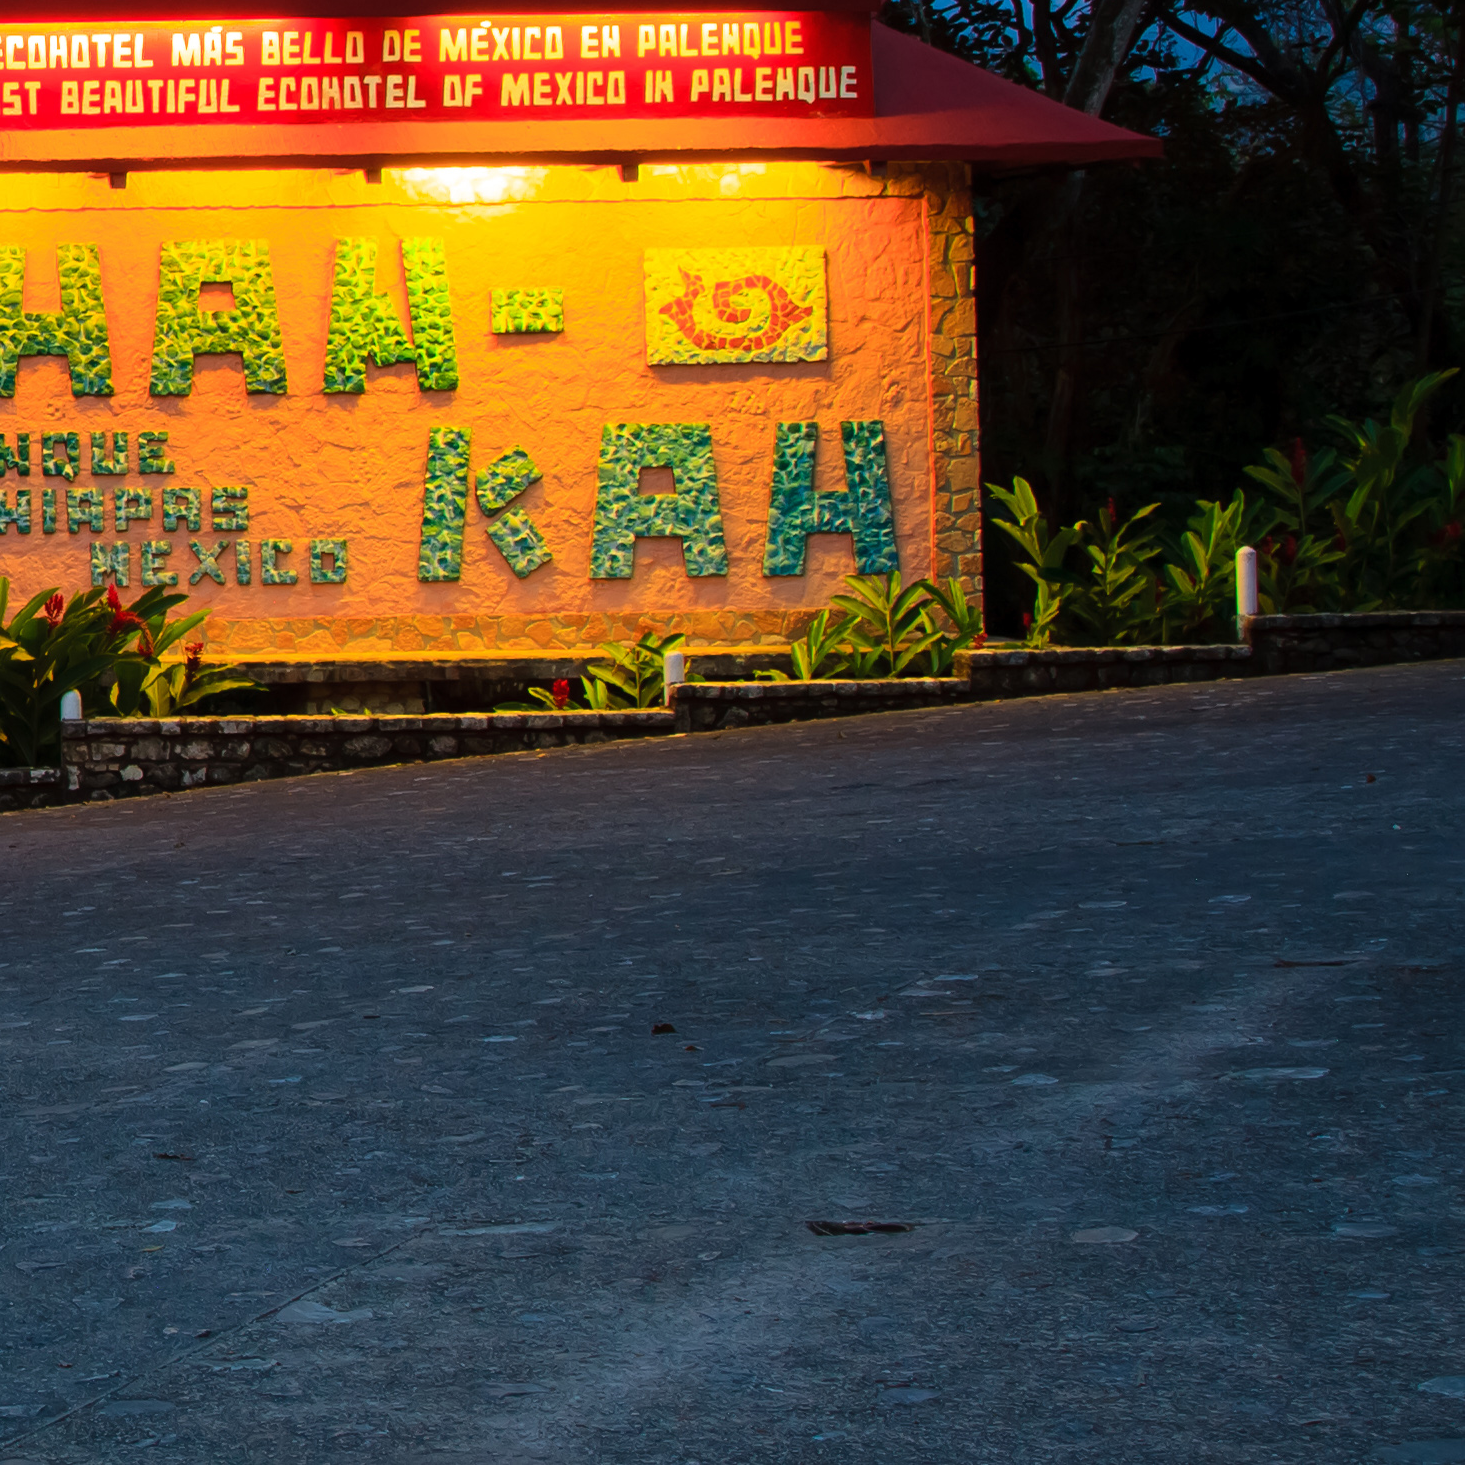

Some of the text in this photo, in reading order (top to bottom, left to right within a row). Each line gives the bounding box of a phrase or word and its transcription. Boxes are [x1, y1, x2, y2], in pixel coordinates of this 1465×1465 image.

[171, 25, 245, 68] MÁS
[261, 30, 365, 65] BELLO
[382, 29, 423, 63] DE
[439, 20, 565, 63] MÉXICO
[580, 25, 621, 60] EN
[637, 21, 805, 60] PALENQUE
[60, 79, 241, 115] BEAUTIFUL
[257, 74, 427, 113] ECOHOTEL
[443, 73, 483, 109] OF
[500, 70, 626, 107] MEXICO
[645, 70, 674, 104] IN
[690, 66, 858, 105] PALENQUE
[417, 420, 901, 583] KAH
[89, 538, 348, 587] MEXICO
